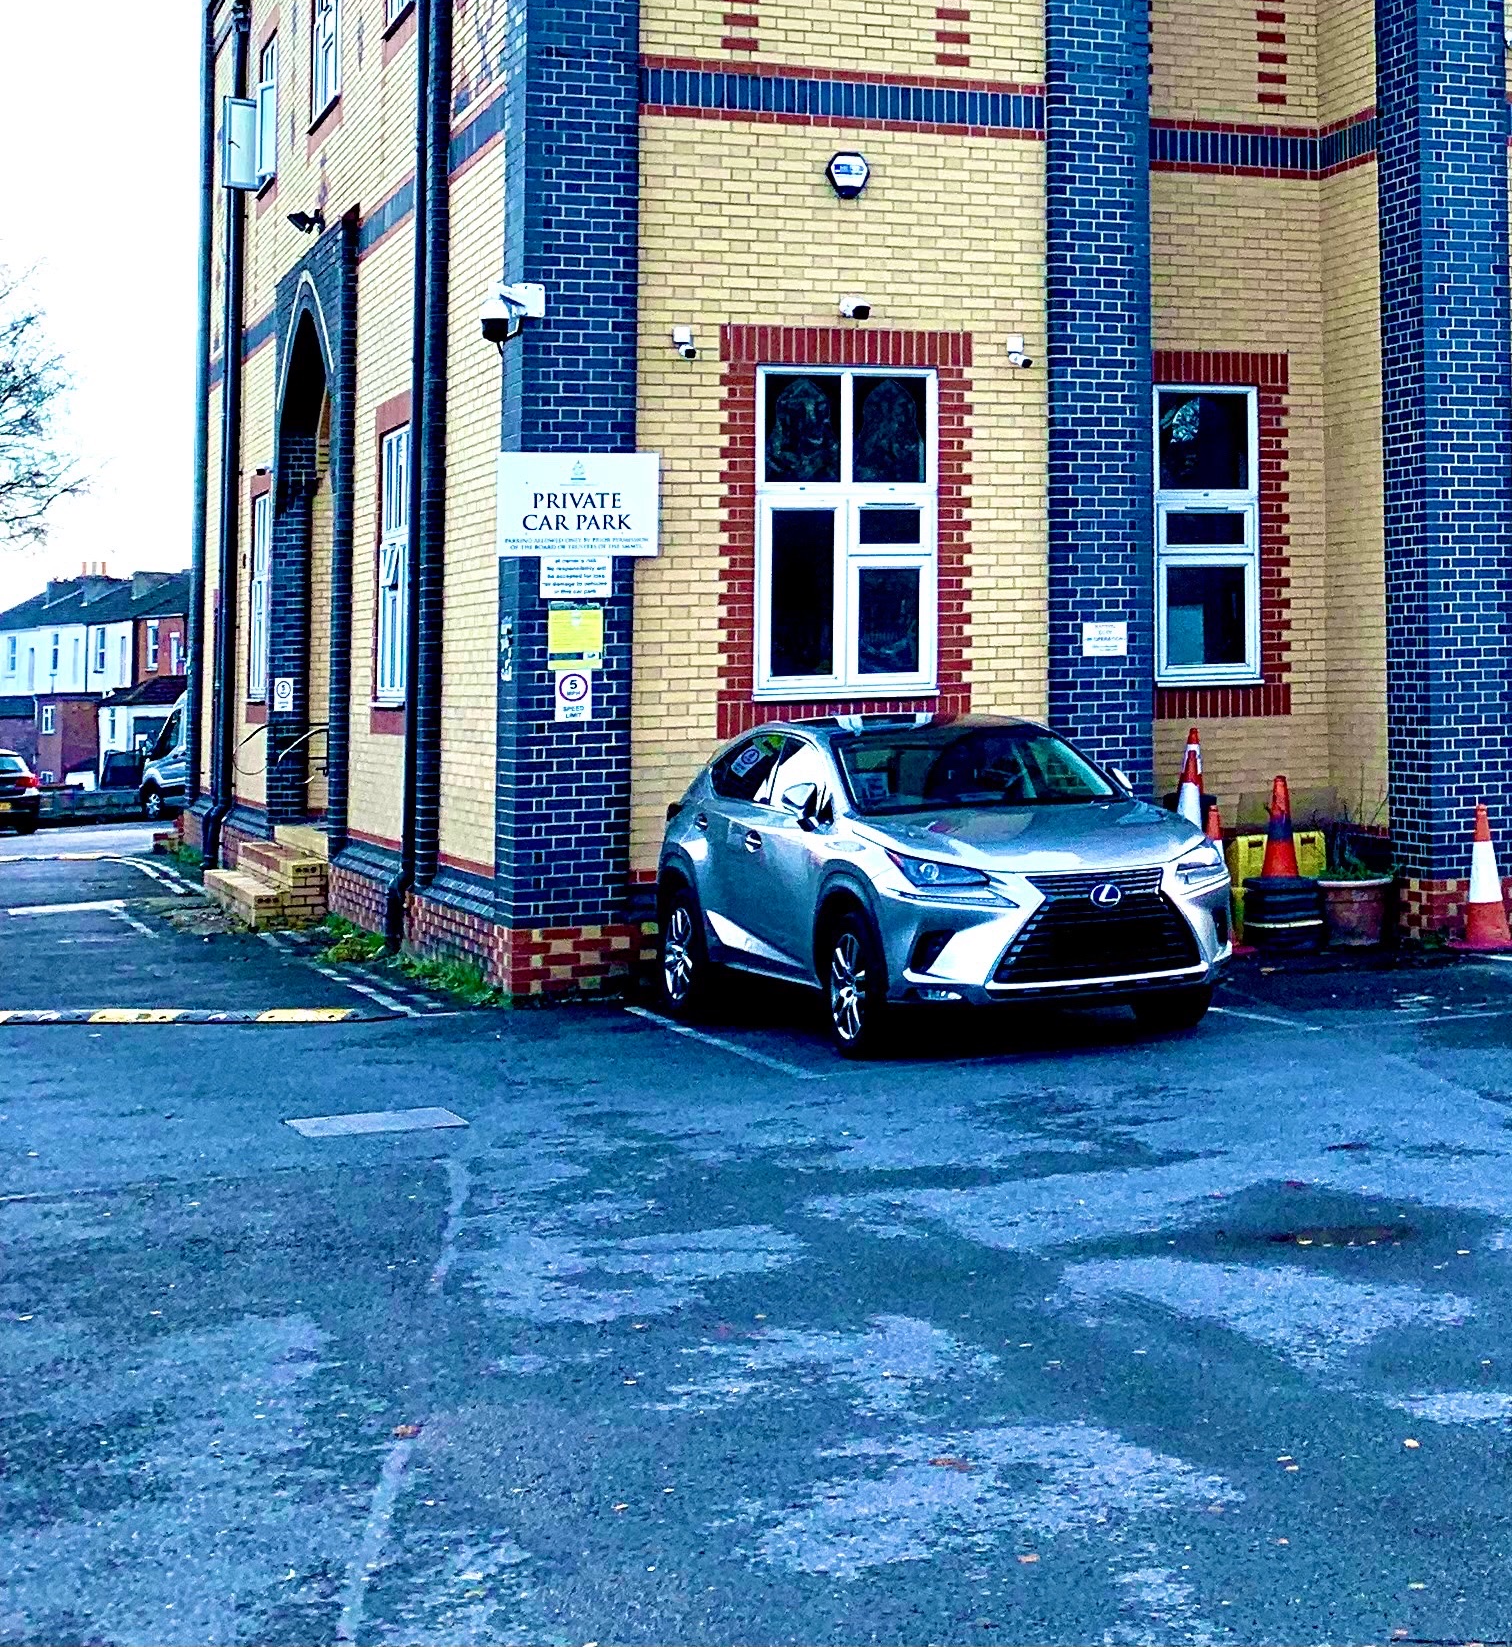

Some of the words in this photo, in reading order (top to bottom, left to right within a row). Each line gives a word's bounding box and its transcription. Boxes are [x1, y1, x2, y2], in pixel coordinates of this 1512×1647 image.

[533, 492, 621, 509] PRIVATE
[522, 514, 570, 531] CAR
[576, 514, 631, 531] PARK
[570, 679, 578, 689] 5
